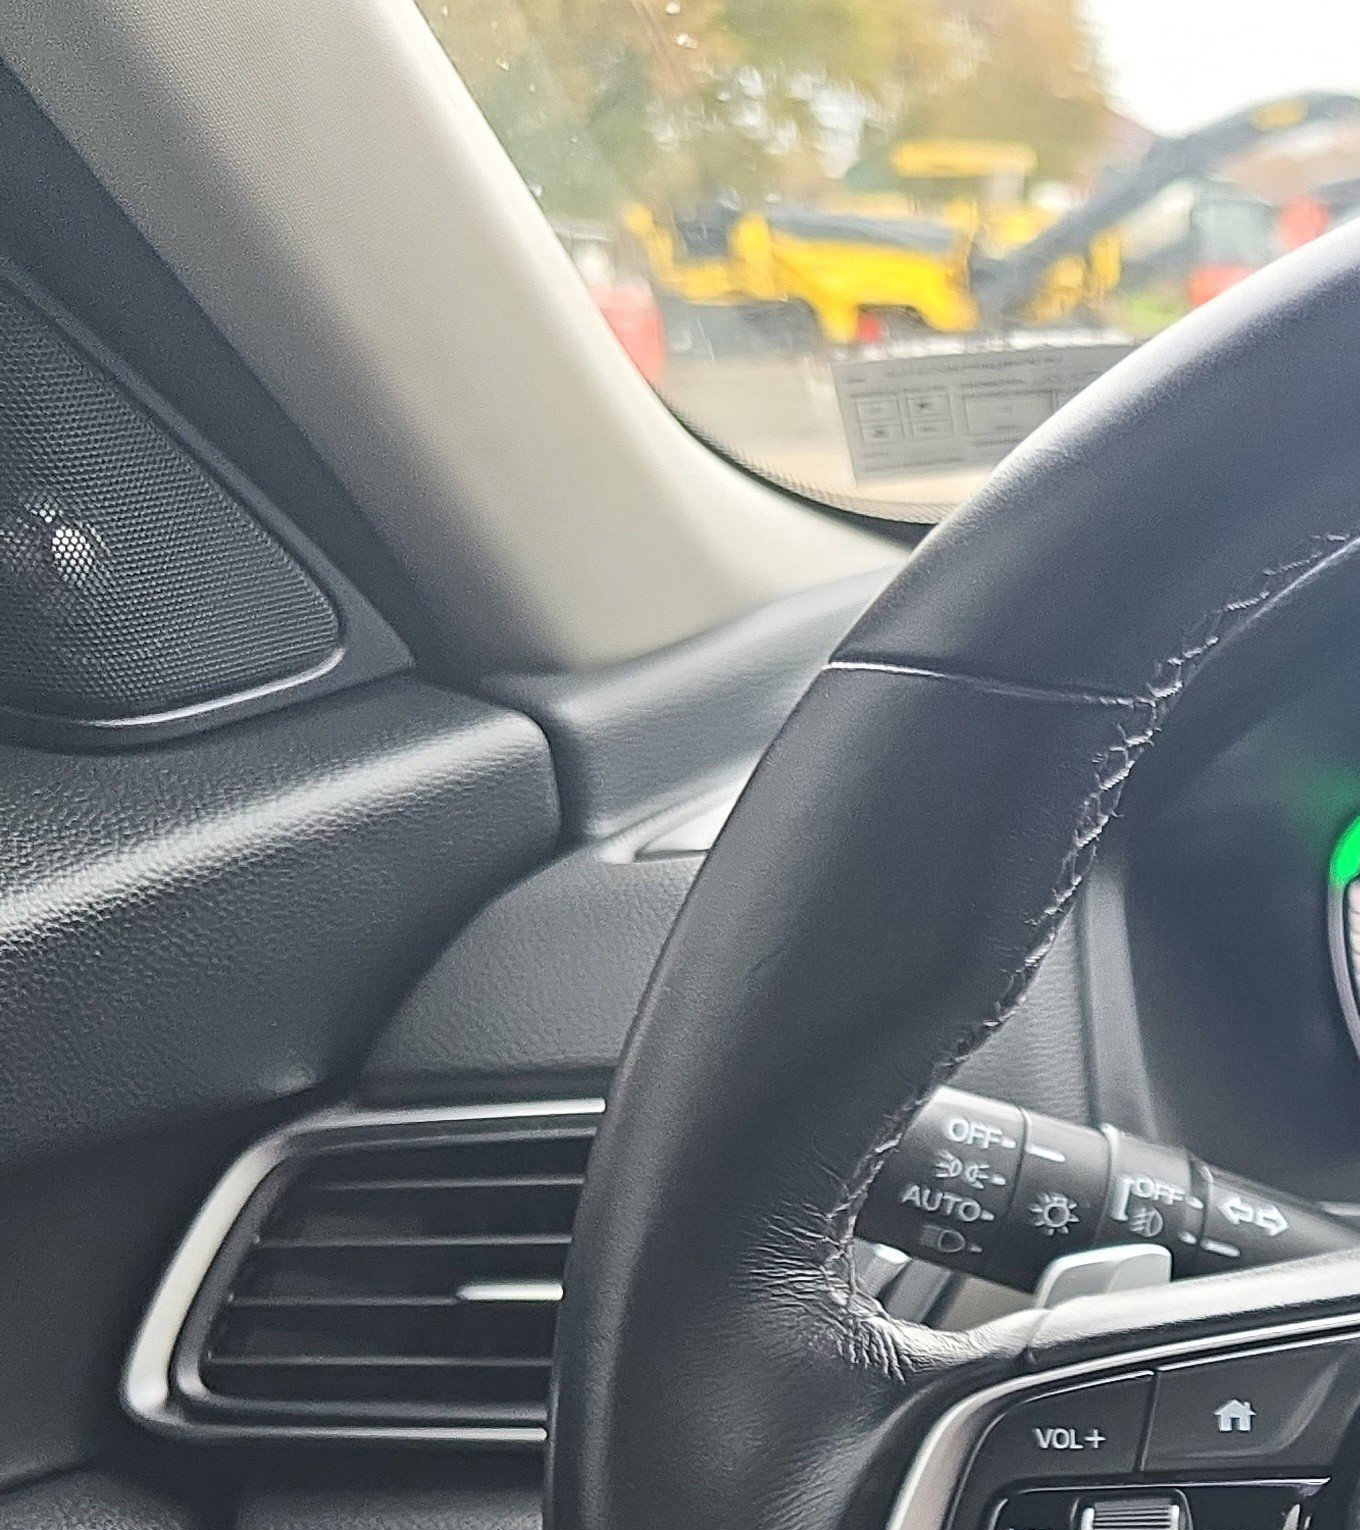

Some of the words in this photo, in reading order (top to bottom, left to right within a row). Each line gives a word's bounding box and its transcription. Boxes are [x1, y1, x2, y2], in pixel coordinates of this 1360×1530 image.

[947, 1117, 1001, 1150] OFF
[901, 1184, 981, 1222] AUTO
[1135, 1178, 1186, 1203] OFF
[1034, 1427, 1107, 1450] VOL+
